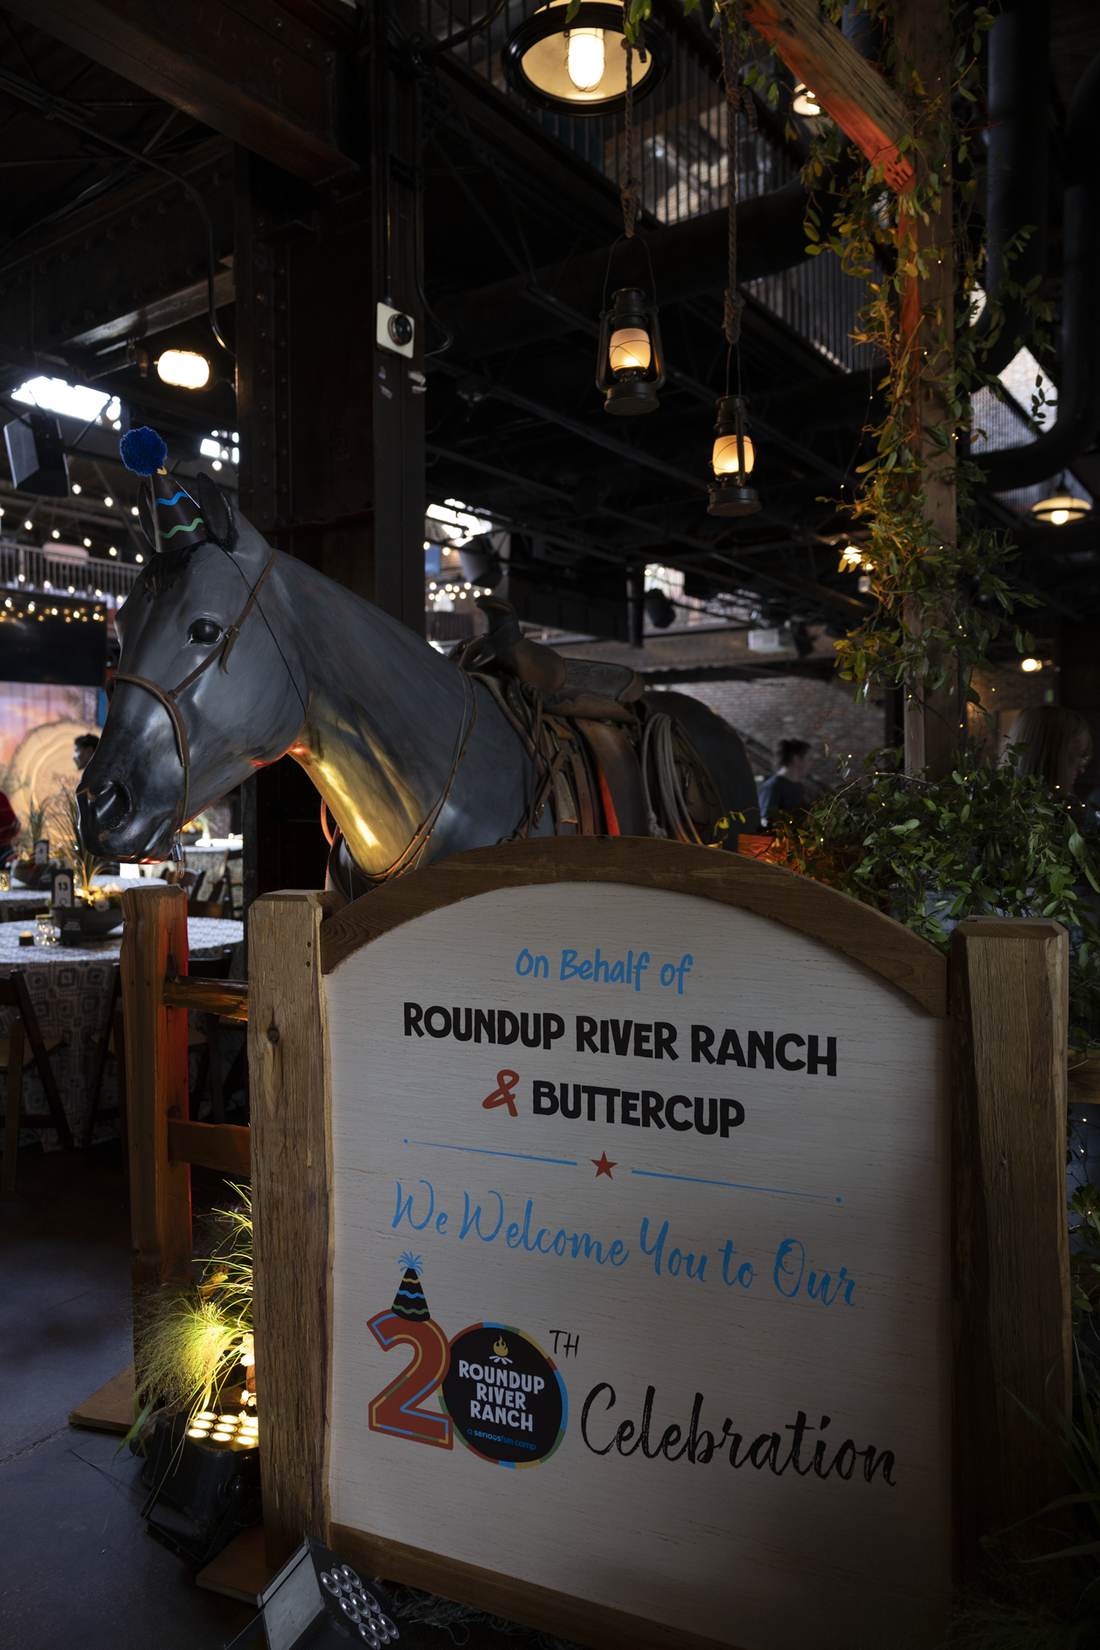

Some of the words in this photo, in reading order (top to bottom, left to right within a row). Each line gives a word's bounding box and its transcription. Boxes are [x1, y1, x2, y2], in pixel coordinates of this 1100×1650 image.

[516, 948, 549, 979] On
[559, 949, 650, 992] Behalf
[659, 954, 694, 995] of
[403, 1001, 566, 1051] ROUNDUP
[576, 1015, 680, 1062] RIVER
[690, 1024, 838, 1077] RANCH
[482, 1068, 520, 1117] &
[532, 1079, 746, 1139] BUTTERCUP
[391, 1179, 449, 1235] We
[458, 1190, 630, 1267] Welcome
[639, 1216, 709, 1289] You
[718, 1239, 756, 1289] to
[772, 1237, 857, 1307] Our
[458, 1359, 545, 1395] ROUNDUP
[475, 1382, 527, 1411] RIVER
[469, 1400, 534, 1433] RANCH
[549, 1329, 580, 1359] TH
[580, 1382, 897, 1488] Celebration
